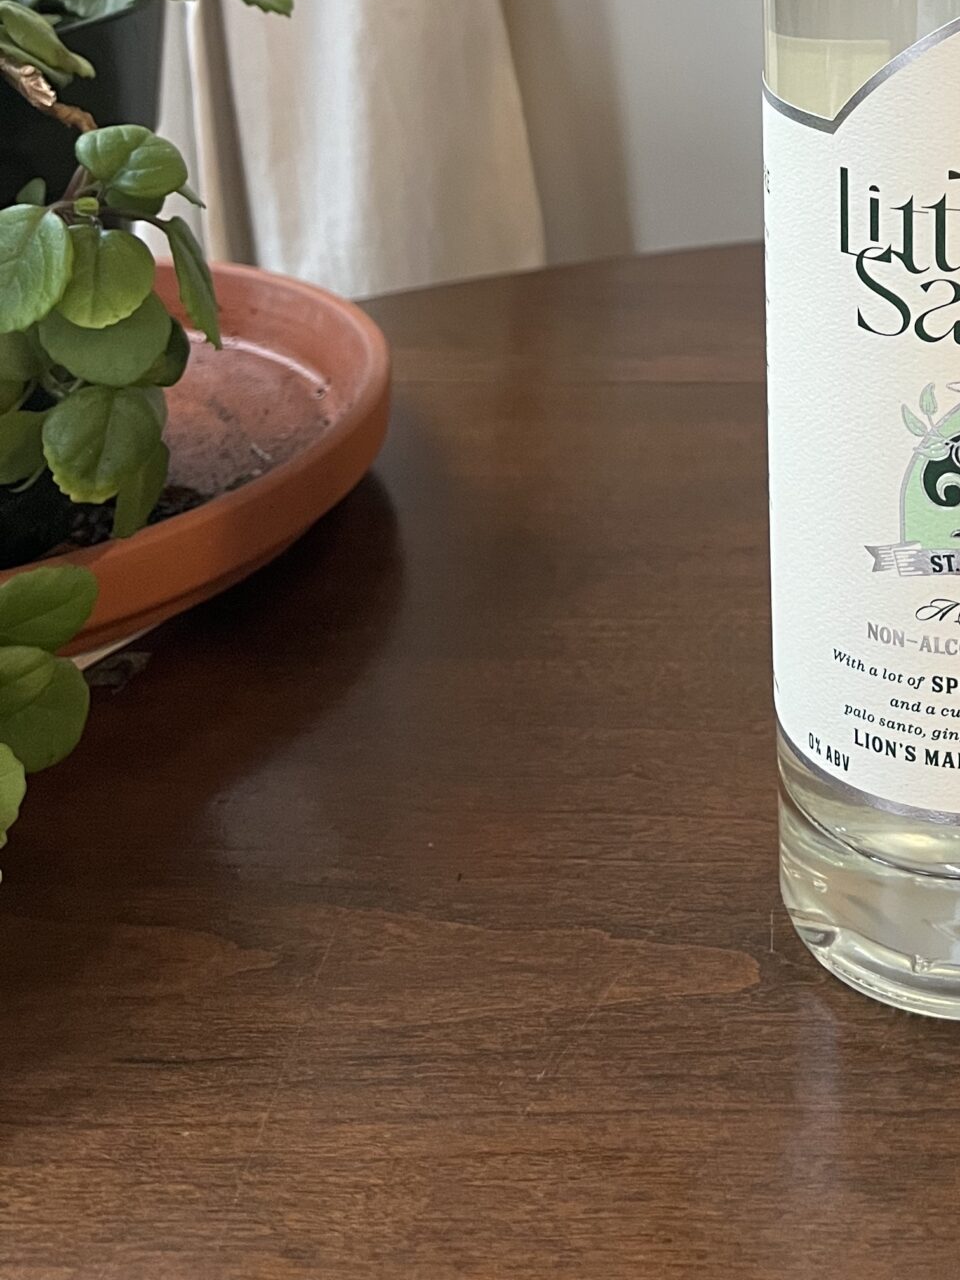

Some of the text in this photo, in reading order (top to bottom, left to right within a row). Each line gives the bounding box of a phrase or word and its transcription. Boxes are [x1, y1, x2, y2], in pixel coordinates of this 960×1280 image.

[930, 554, 960, 573] ST.
[833, 648, 866, 673] With
[869, 666, 878, 677] a
[882, 668, 903, 684] lot
[907, 676, 925, 690] of
[844, 703, 875, 723] palo
[879, 717, 926, 739] santo,
[890, 697, 921, 713] and
[926, 705, 936, 715] a
[808, 732, 850, 772] 0% ABV
[853, 727, 917, 762] LION'S
